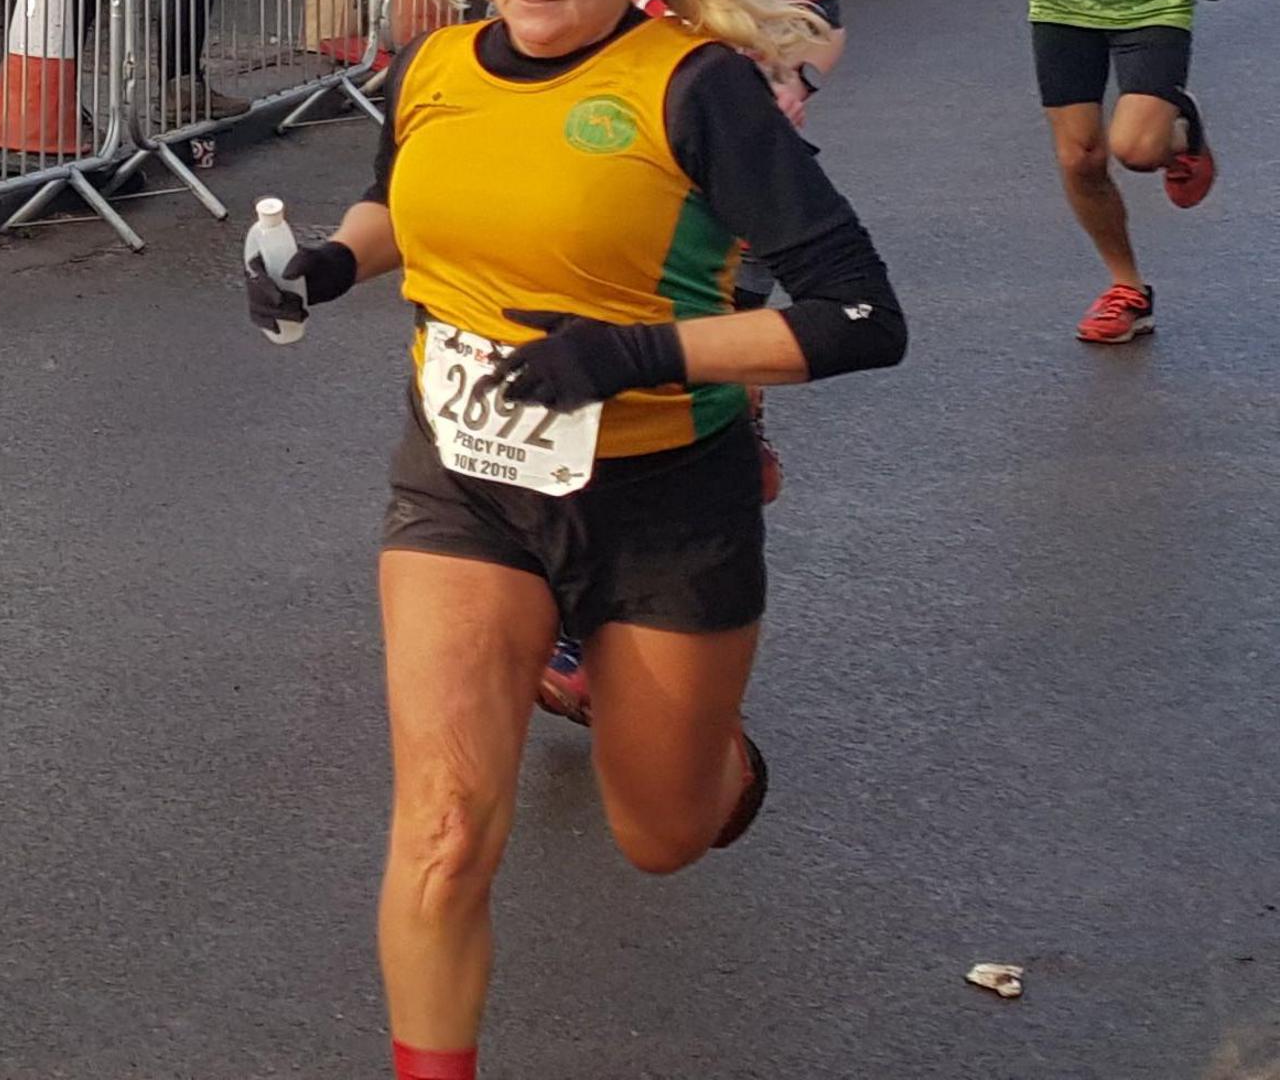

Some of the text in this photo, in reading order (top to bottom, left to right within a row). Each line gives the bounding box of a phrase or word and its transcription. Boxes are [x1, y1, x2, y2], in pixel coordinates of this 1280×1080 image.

[438, 363, 559, 451] 2692
[453, 429, 527, 463] PERCY PUD
[453, 453, 518, 481] 10K 2019
